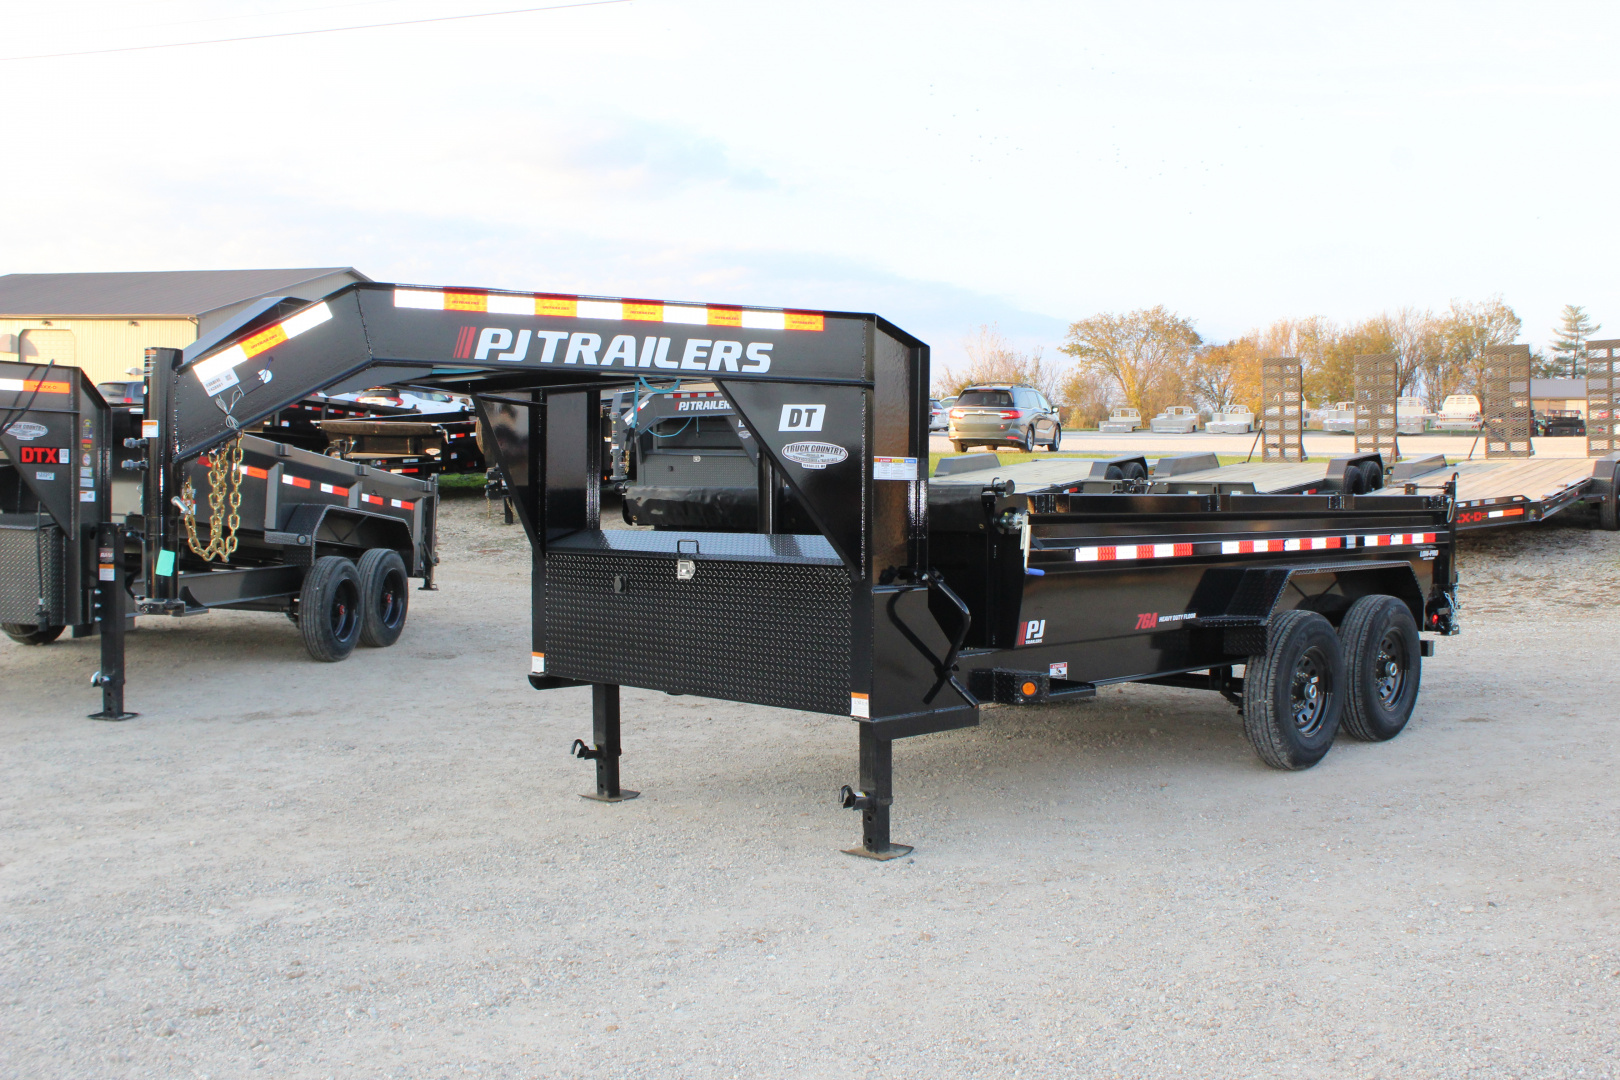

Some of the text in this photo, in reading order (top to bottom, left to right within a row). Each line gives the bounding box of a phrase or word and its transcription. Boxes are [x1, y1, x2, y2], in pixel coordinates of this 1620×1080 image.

[474, 327, 774, 374] PJ TRAILERS
[678, 401, 690, 411] PJ
[787, 408, 817, 428] DT
[21, 446, 58, 464] DTX
[786, 444, 844, 455] TRUCK COUNTRY
[1158, 615, 1172, 623] HEAVY
[1183, 612, 1197, 620] FLOOR
[1025, 619, 1046, 640] PJ
